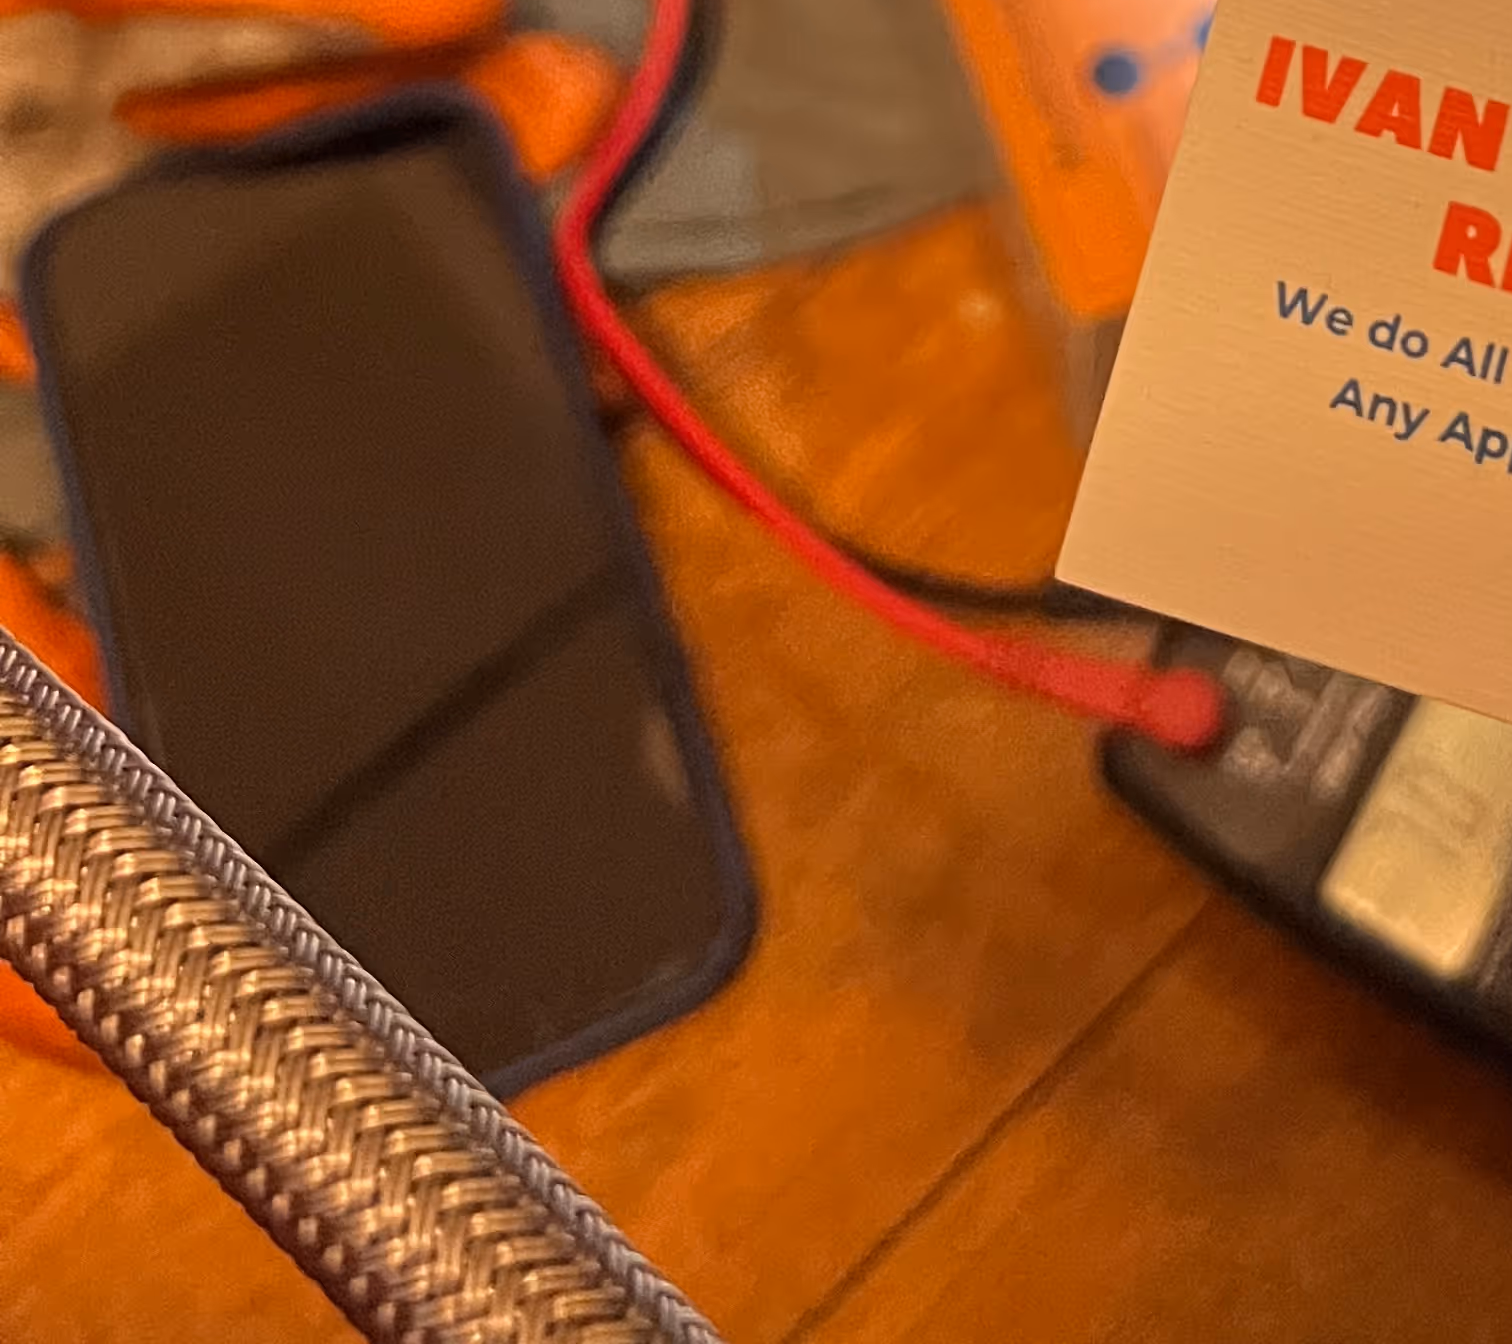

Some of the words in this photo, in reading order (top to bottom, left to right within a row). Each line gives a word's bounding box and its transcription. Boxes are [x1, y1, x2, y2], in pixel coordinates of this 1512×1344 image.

[1254, 35, 1511, 173] IVAN
[1275, 279, 1354, 338] We
[1367, 313, 1430, 360] do
[1439, 335, 1510, 385] All
[1328, 377, 1431, 442] Any
